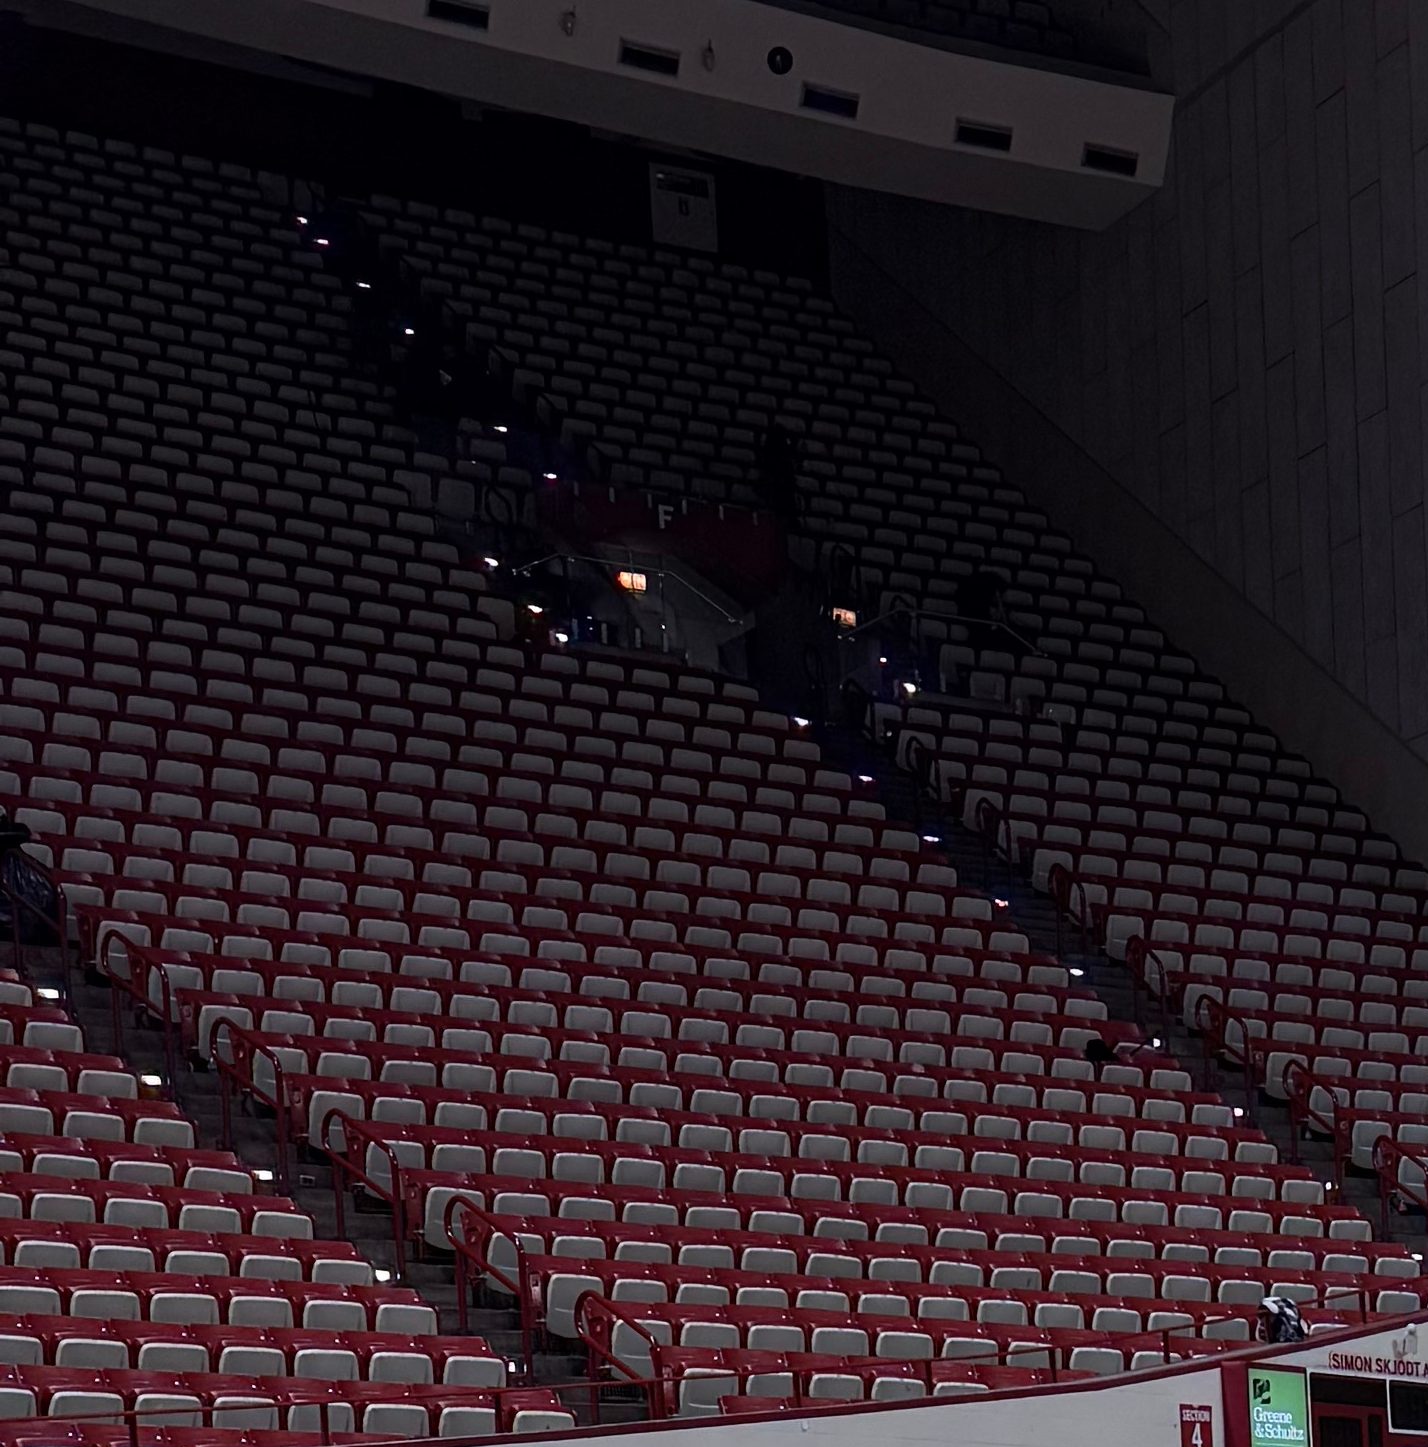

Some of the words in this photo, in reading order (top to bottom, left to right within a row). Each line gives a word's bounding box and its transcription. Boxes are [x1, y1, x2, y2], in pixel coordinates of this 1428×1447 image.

[658, 504, 674, 528] F
[1330, 1353, 1372, 1373] SIMON
[1376, 1358, 1421, 1378] SKJODT
[1253, 1407, 1293, 1423] Greene
